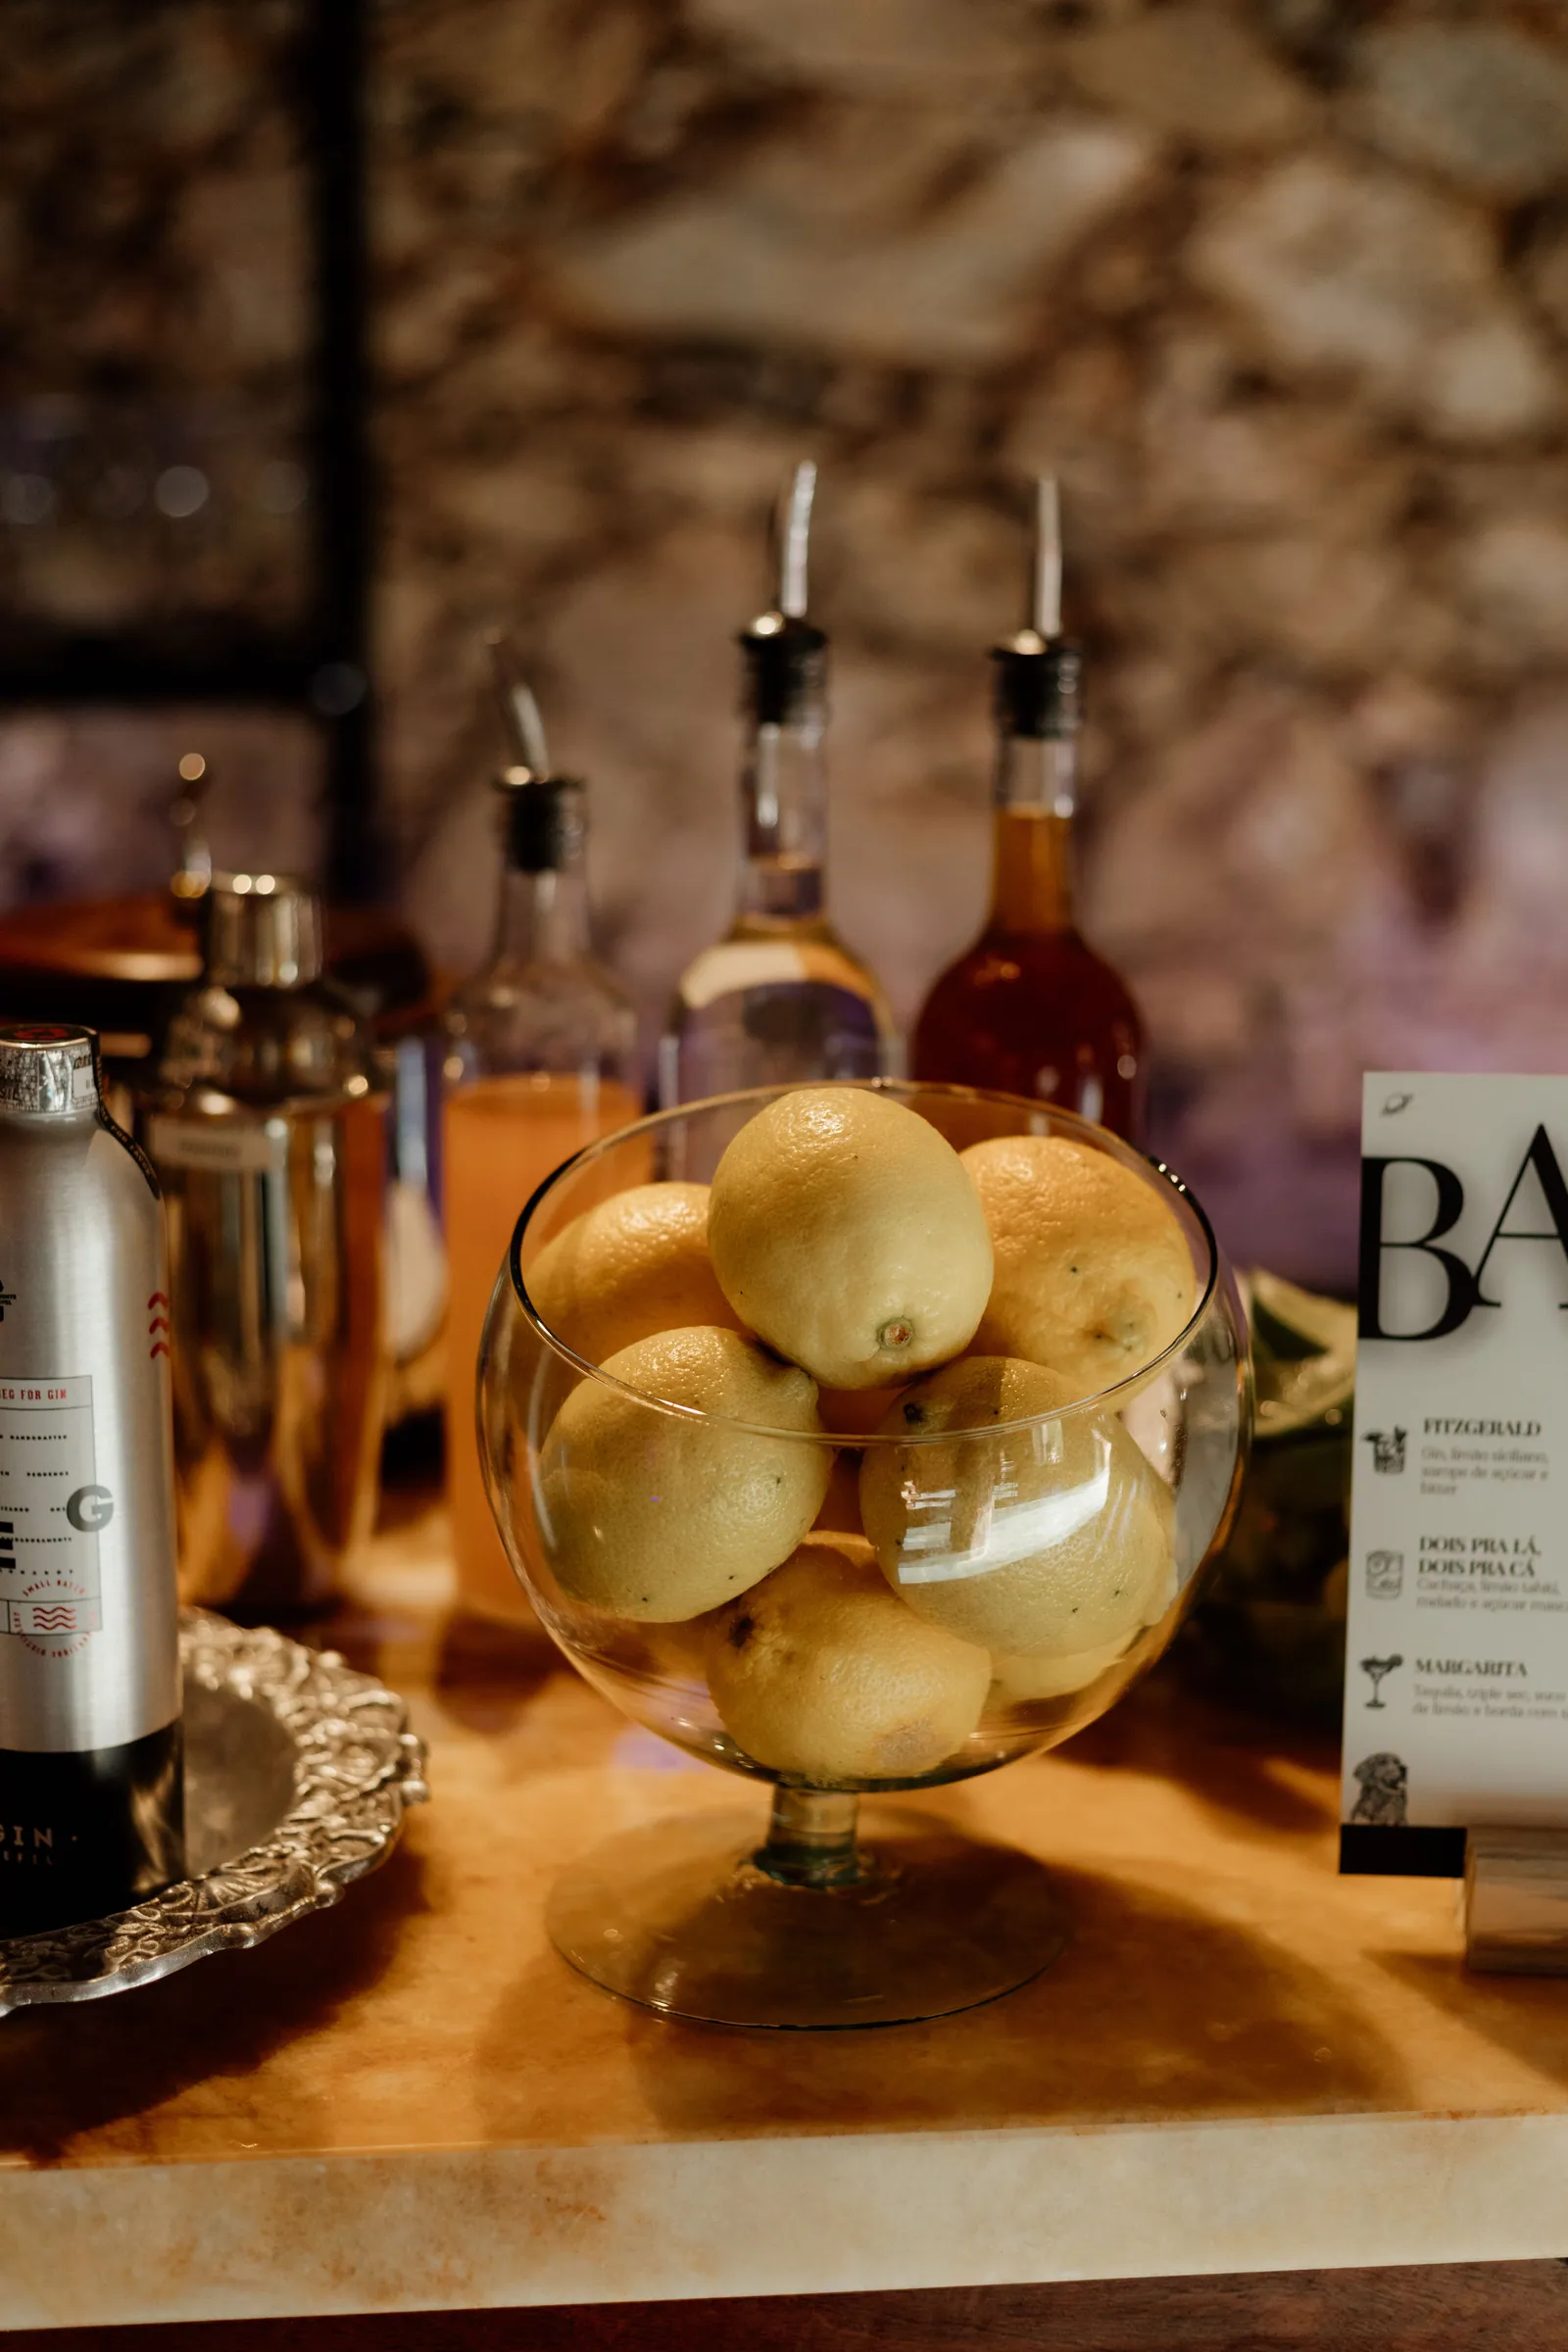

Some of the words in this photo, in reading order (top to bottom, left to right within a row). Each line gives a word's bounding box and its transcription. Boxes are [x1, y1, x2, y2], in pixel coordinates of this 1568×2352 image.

[0, 1387, 15, 1400] EG
[21, 1389, 41, 1400] FOR
[47, 1388, 67, 1400] GIN
[1423, 1418, 1542, 1437] FITZGERALD
[66, 1484, 114, 1532] G
[1419, 1536, 1465, 1552] DOIS
[1471, 1537, 1507, 1554] PRA
[1418, 1557, 1465, 1575] DOIS
[1470, 1559, 1505, 1576] PRA
[1415, 1658, 1528, 1677] MARGARITA
